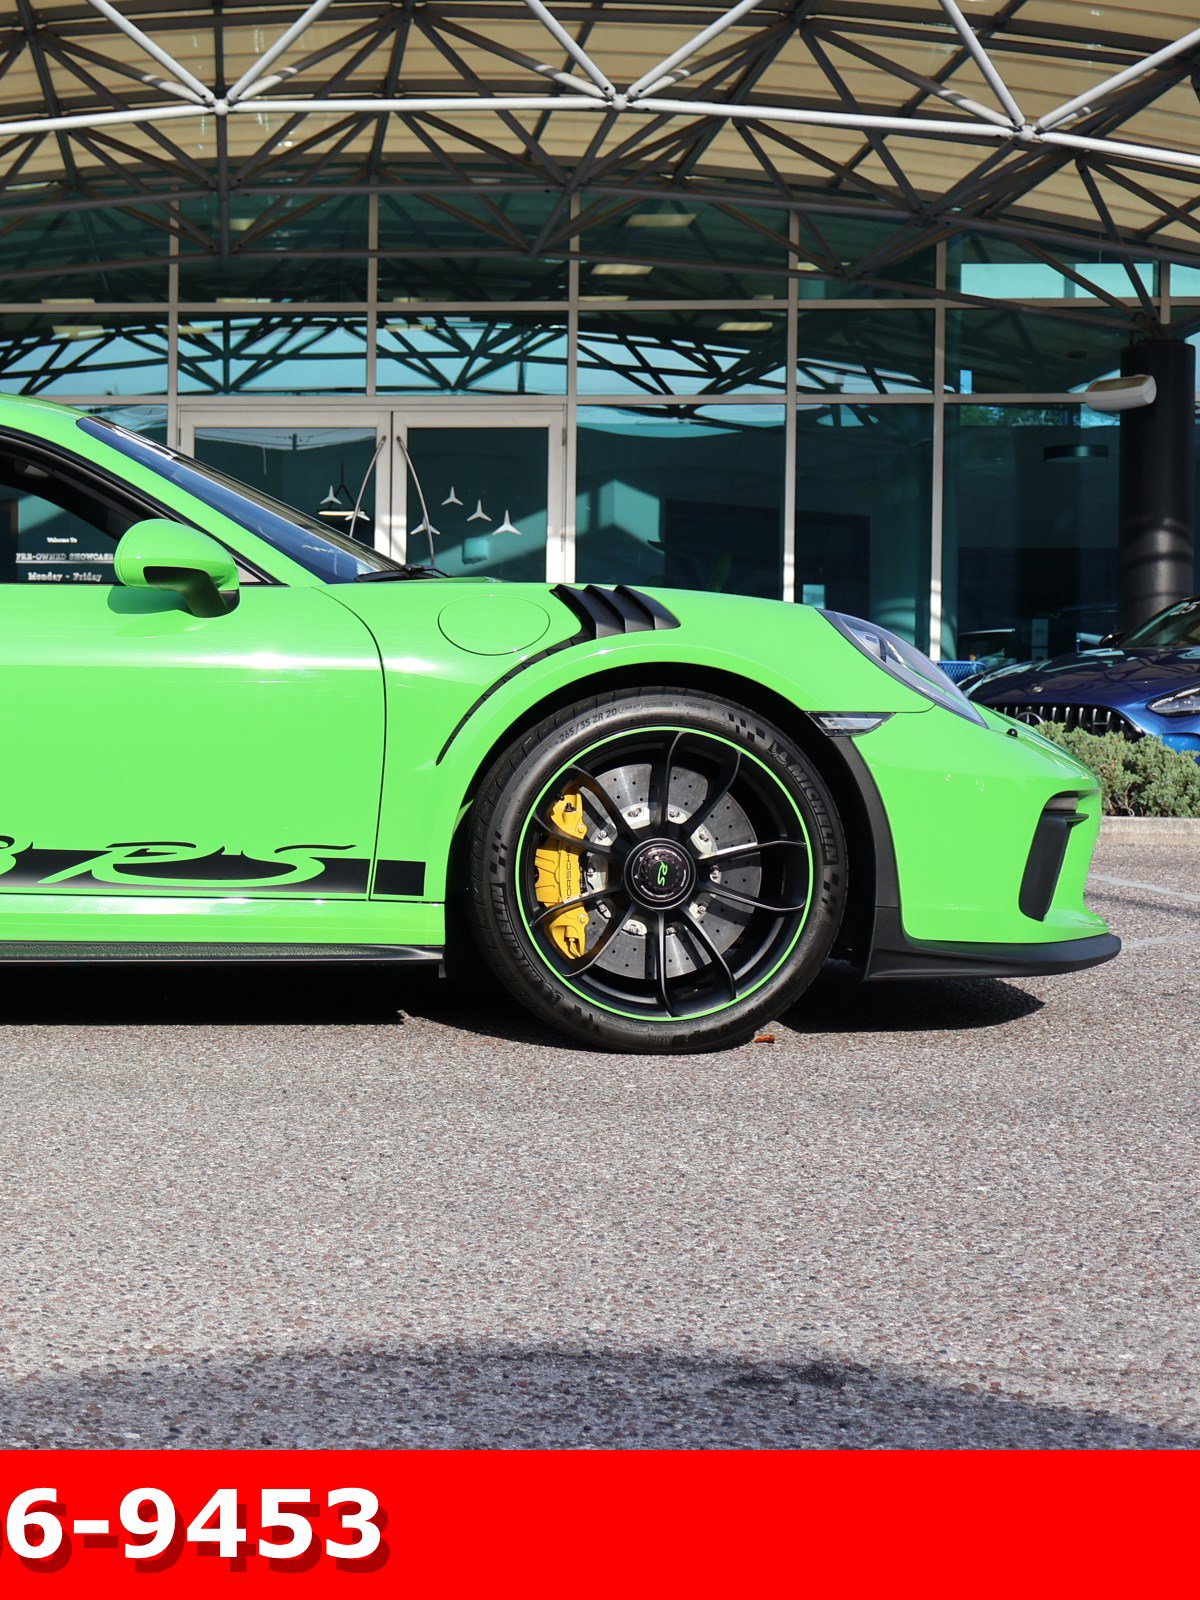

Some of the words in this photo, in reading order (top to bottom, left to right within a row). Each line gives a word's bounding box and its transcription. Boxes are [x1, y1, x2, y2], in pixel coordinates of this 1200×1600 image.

[15, 553, 67, 562] PRE-OWNED
[27, 572, 63, 582] Monday
[73, 572, 102, 582] Friday
[558, 718, 592, 743] 265/35
[604, 707, 618, 719] 20
[787, 760, 838, 863] MICHELIN
[36, 841, 357, 889] RS
[657, 861, 668, 886] RS
